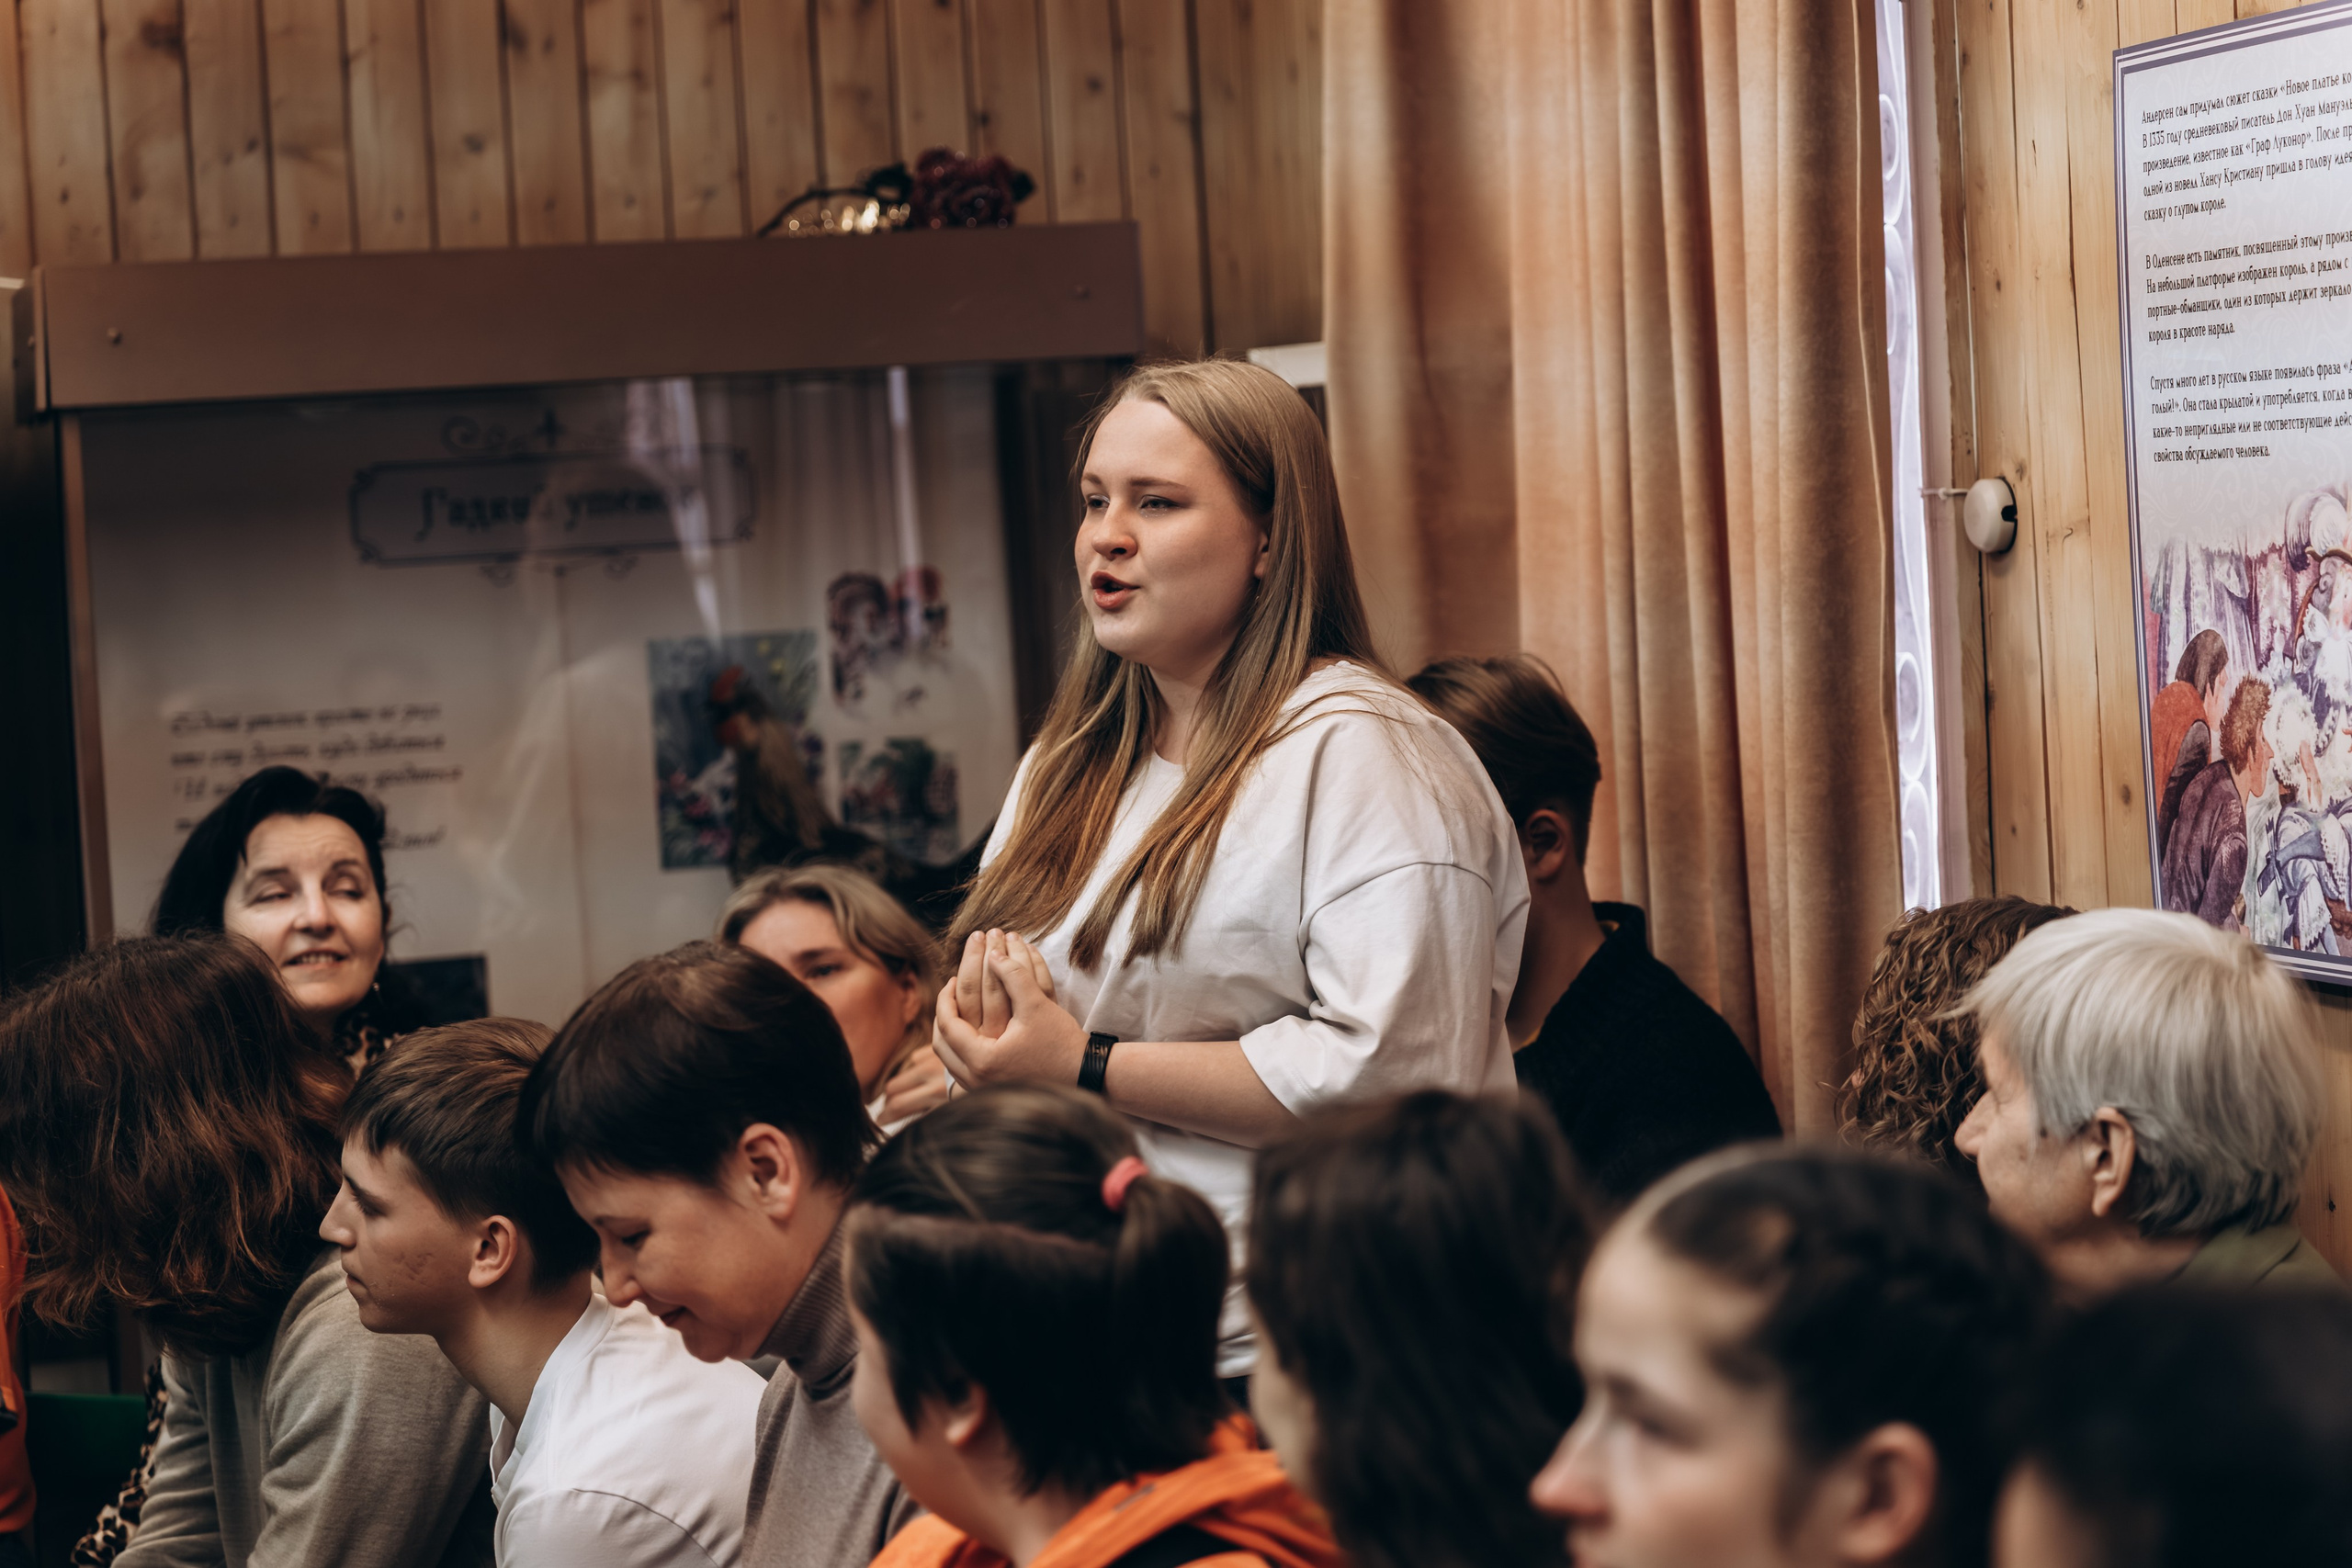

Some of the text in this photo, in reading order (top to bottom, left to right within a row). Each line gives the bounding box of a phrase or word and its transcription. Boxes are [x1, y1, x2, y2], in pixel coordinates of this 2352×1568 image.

[2142, 73, 2351, 125] Андерсен сам придумал сюжет сказки «Новое платье ко
[2143, 134, 2147, 148] В
[2150, 130, 2165, 147] 1335
[2166, 130, 2182, 145] году
[2184, 117, 2239, 143] средневековый
[2241, 113, 2275, 130] писатель
[2277, 108, 2292, 123] Дон
[2295, 104, 2315, 122] Хуан
[2193, 147, 2229, 164] известное
[2231, 144, 2244, 156] как
[2245, 138, 2271, 156] «Граф
[2273, 131, 2313, 152] Луконор».
[2316, 126, 2340, 141] После
[2143, 180, 2163, 197] одной
[2165, 182, 2173, 193] из
[2175, 178, 2198, 191] новелл
[2199, 172, 2222, 188] Хансу
[2224, 166, 2264, 186] Кристиану
[2267, 161, 2296, 179] пришла
[2299, 160, 2303, 171] в
[2305, 154, 2332, 170] голову
[2144, 198, 2226, 222] сказку о глупом короле.
[2146, 255, 2151, 269] В
[2153, 254, 2185, 269] Оденсене
[2187, 252, 2202, 264] есть
[2204, 246, 2241, 261] памятник,
[2244, 235, 2298, 256] посвященный
[2301, 234, 2323, 250] этому
[2146, 258, 2348, 293] На небольшой платформе изображен король, а рядом с
[2224, 297, 2242, 310] один
[2244, 296, 2252, 306] из
[2254, 291, 2287, 308] которых
[2289, 288, 2317, 305] держит
[2149, 322, 2235, 345] короля в красоте наряда.
[2151, 376, 2174, 393] Спустя
[2177, 377, 2197, 388] много
[2199, 375, 2210, 386] лет
[2211, 375, 2216, 385] в
[2218, 372, 2247, 389] русском
[2249, 369, 2272, 381] языке
[2275, 366, 2314, 379] появилась
[2316, 364, 2341, 380] фраза
[2152, 398, 2181, 414] голый!».
[2183, 398, 2197, 412] Она
[2199, 400, 2217, 411] стала
[2220, 393, 2254, 413] крылатой
[2256, 396, 2260, 406] и
[2323, 389, 2346, 401] когда
[2153, 426, 2183, 438] какие-то
[2185, 423, 2236, 440] неприглядные
[2238, 422, 2251, 433] или
[2253, 421, 2262, 432] не
[2264, 416, 2332, 433] соответствующие
[2154, 446, 2270, 464] свойства обсуждаемого человека.
